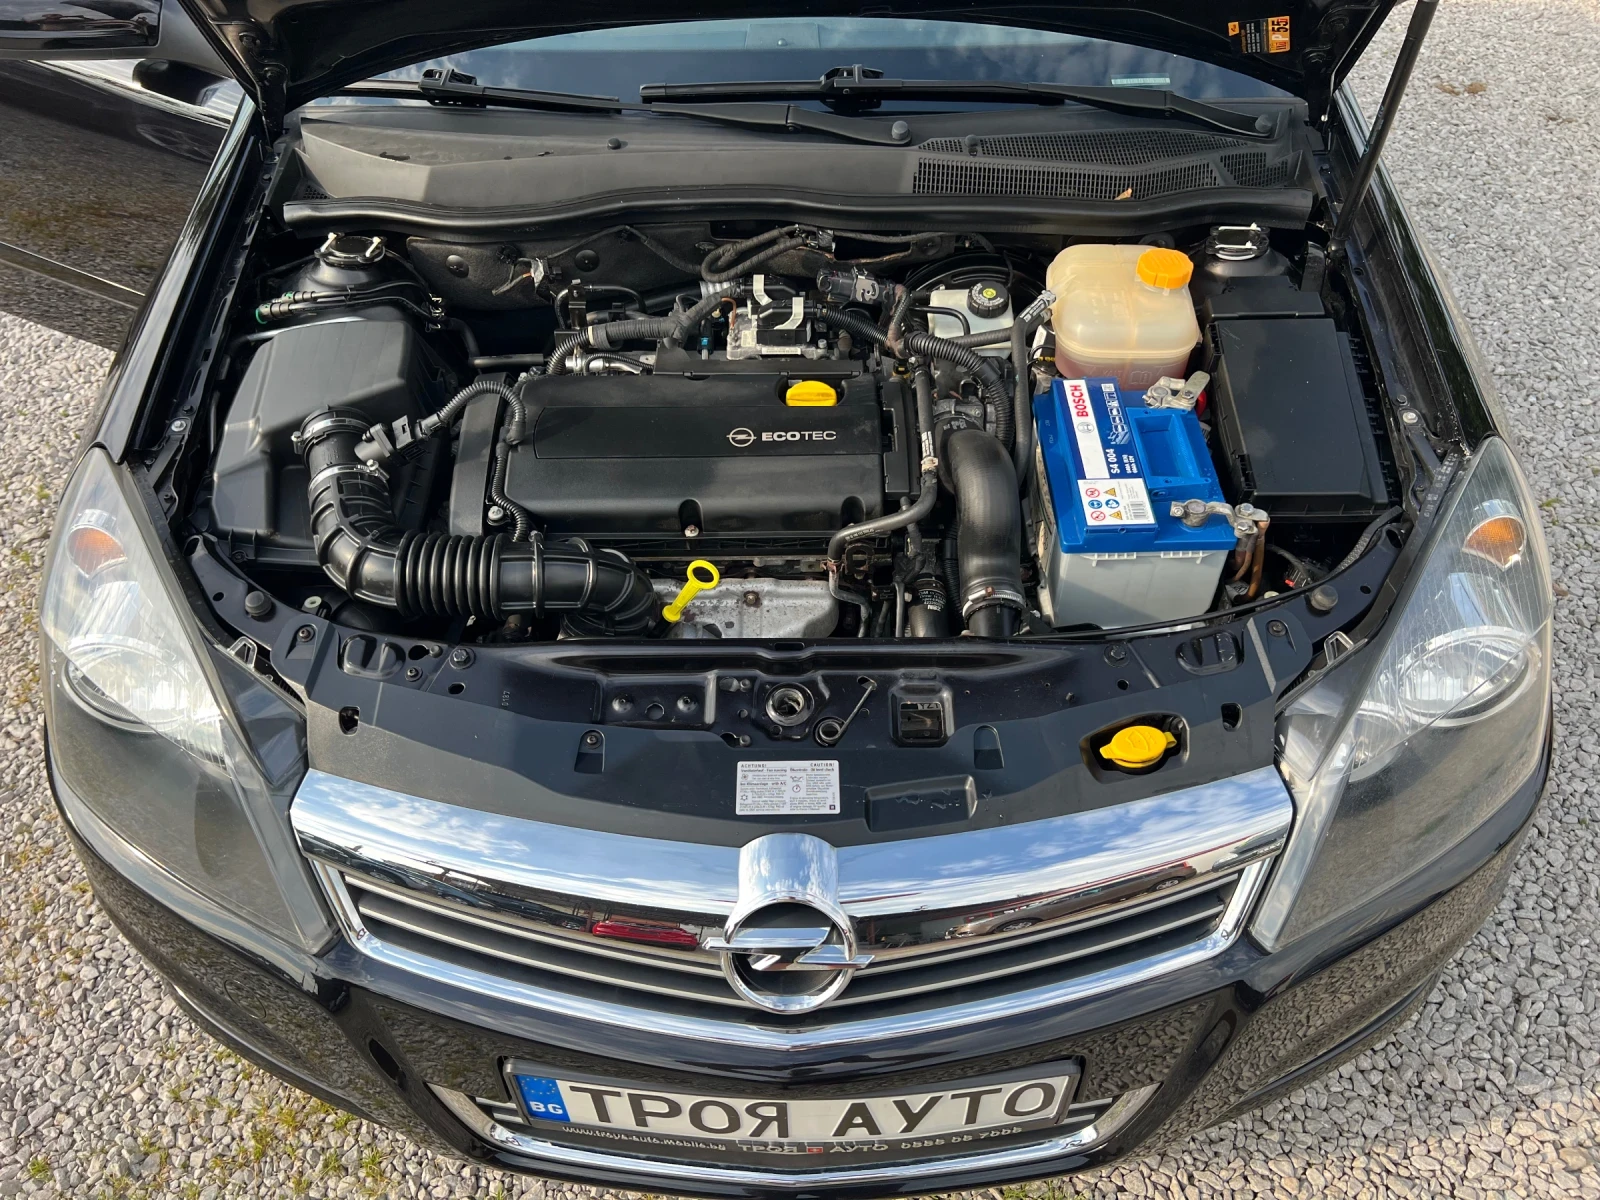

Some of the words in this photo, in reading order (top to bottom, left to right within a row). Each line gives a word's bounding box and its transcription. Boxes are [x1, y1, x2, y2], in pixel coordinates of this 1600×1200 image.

[1069, 385, 1089, 417] BOSCH
[761, 431, 837, 442] ECOTEC
[1105, 448, 1117, 463] 004
[1109, 463, 1120, 474] S4
[529, 1101, 564, 1115] BG
[568, 1085, 789, 1139] ТРОЯ
[830, 1081, 1056, 1138] АУТО
[737, 1144, 798, 1154] ТРОЯ
[829, 1143, 889, 1153] АУТО
